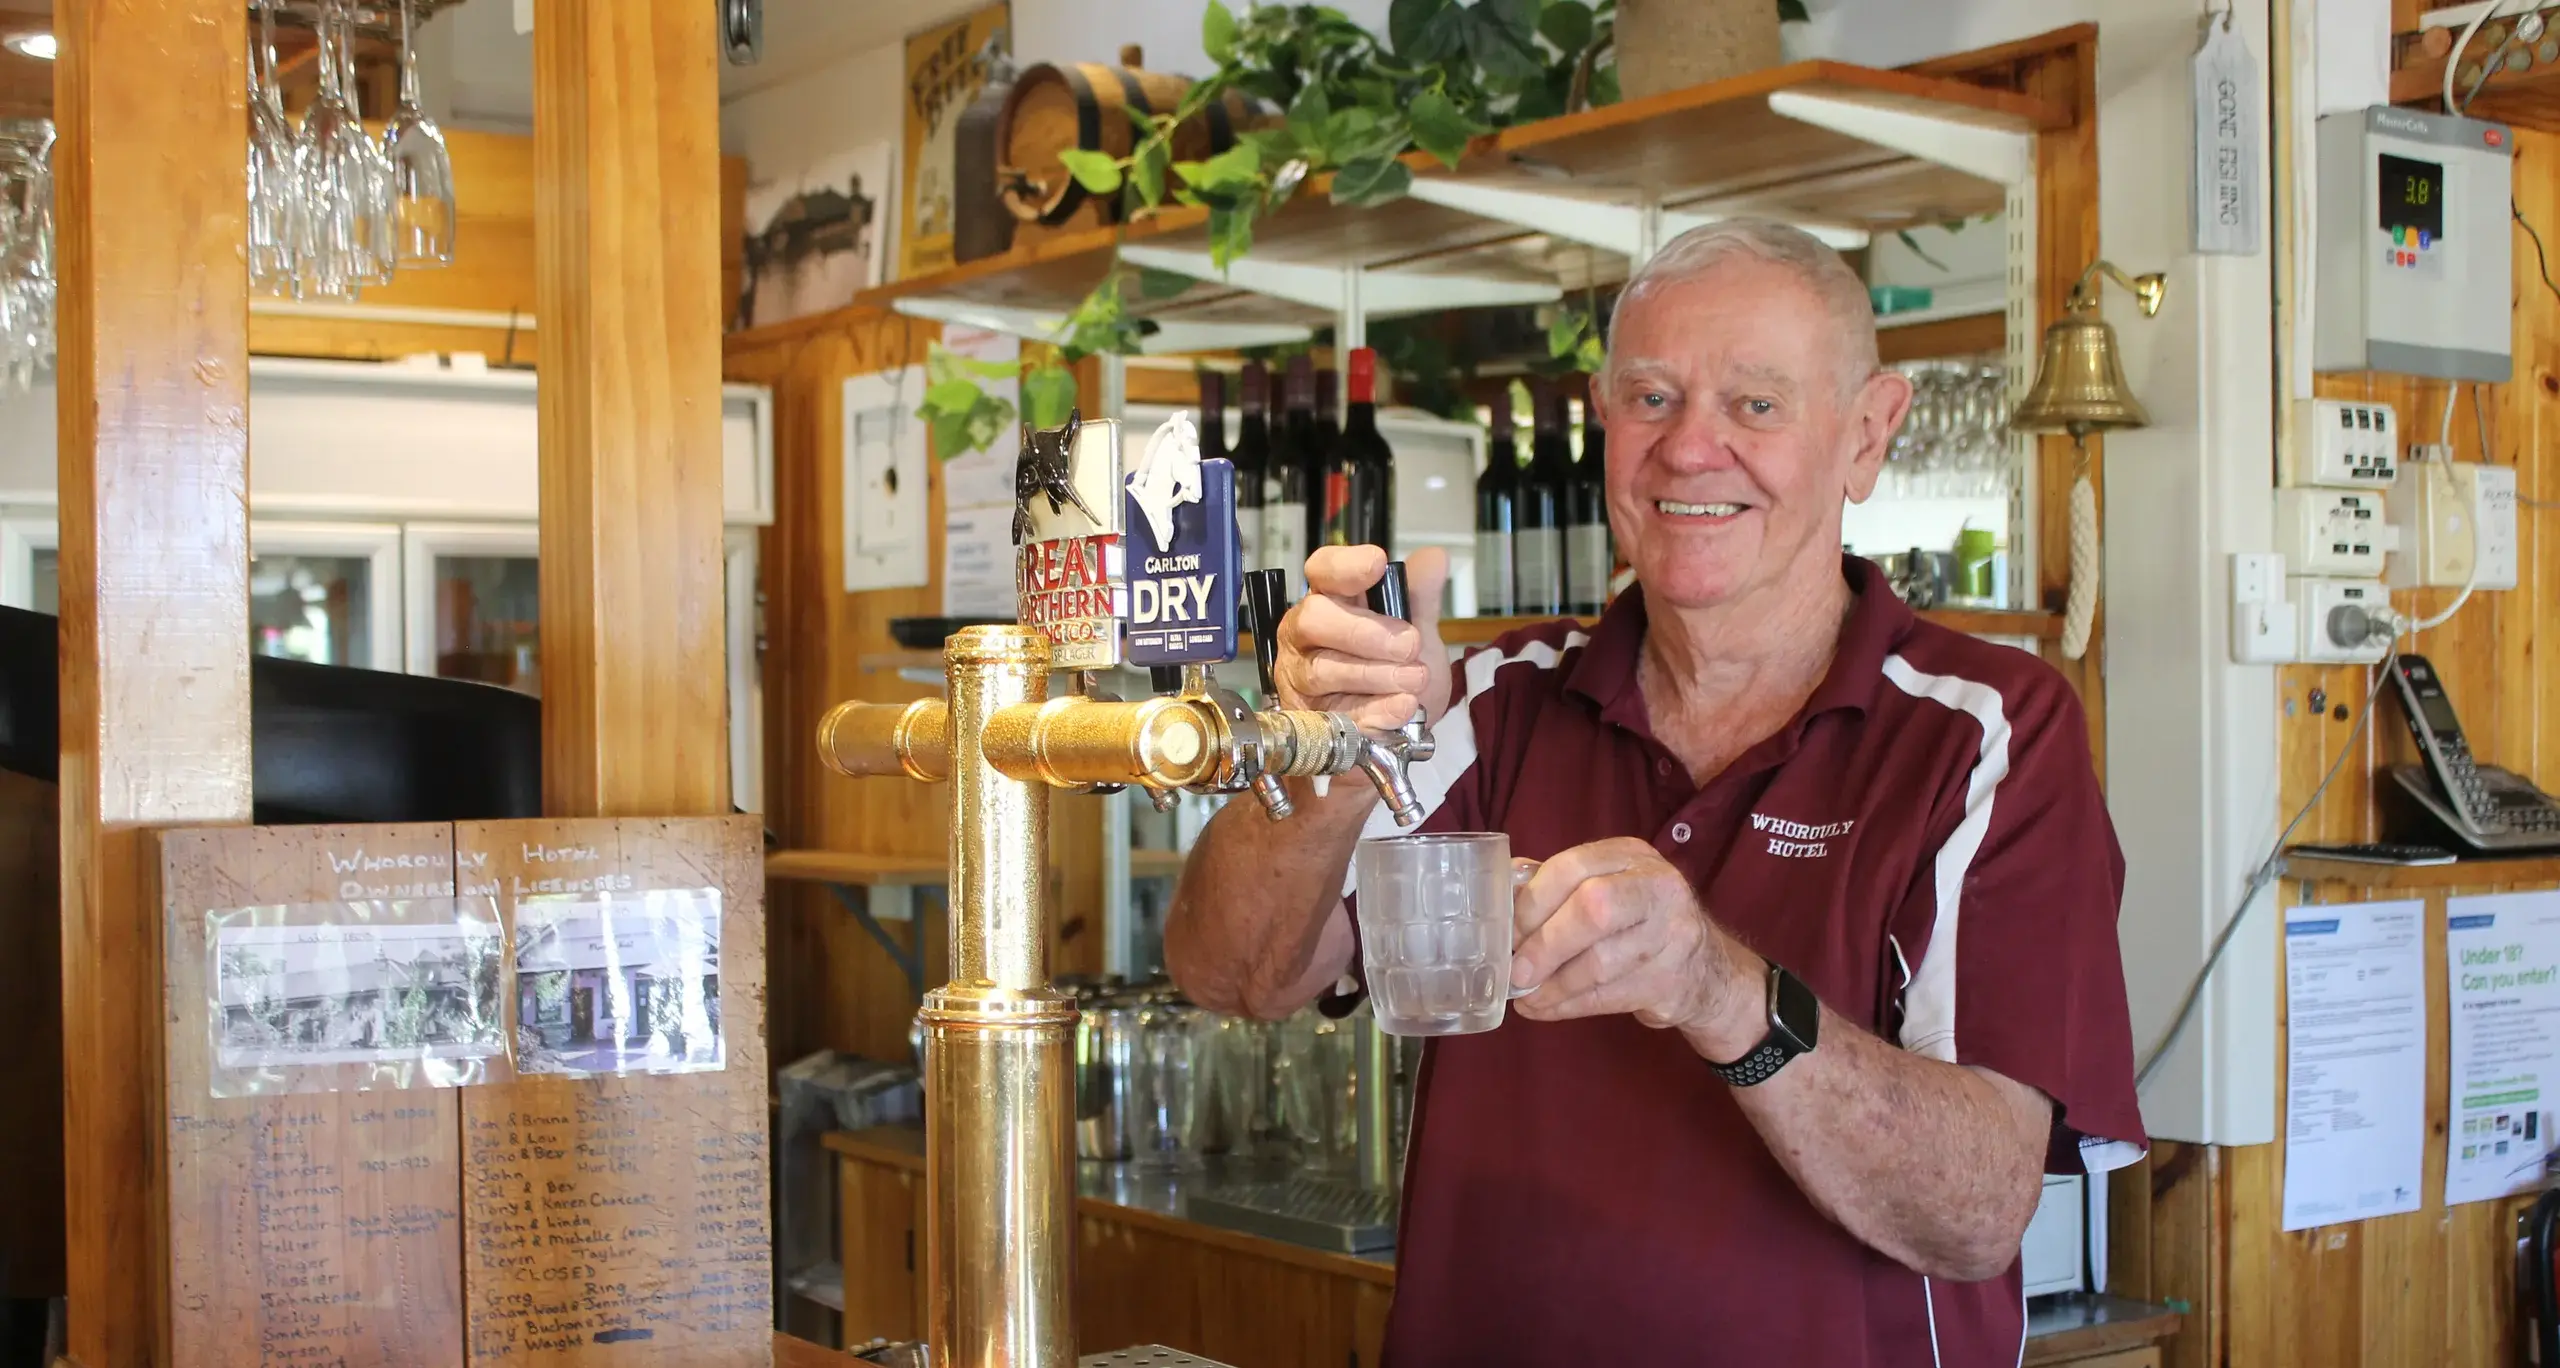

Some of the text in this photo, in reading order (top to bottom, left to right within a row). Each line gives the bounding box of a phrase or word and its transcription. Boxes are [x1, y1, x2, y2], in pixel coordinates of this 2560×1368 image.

[2217, 78, 2238, 139] GONE
[2405, 176, 2430, 204] 3.8
[1145, 554, 1202, 575] CARLTON
[1133, 573, 1218, 624] DRY
[1751, 813, 1854, 840] WHOROULY
[1766, 838, 1828, 858] HOTEL
[2461, 943, 2524, 967] Under 18?
[2461, 964, 2558, 993] Can you enter?
[478, 1168, 524, 1183] John
[515, 1266, 596, 1282] CLOSED
[584, 1282, 627, 1297] Ring
[266, 1310, 321, 1328] Kelly
